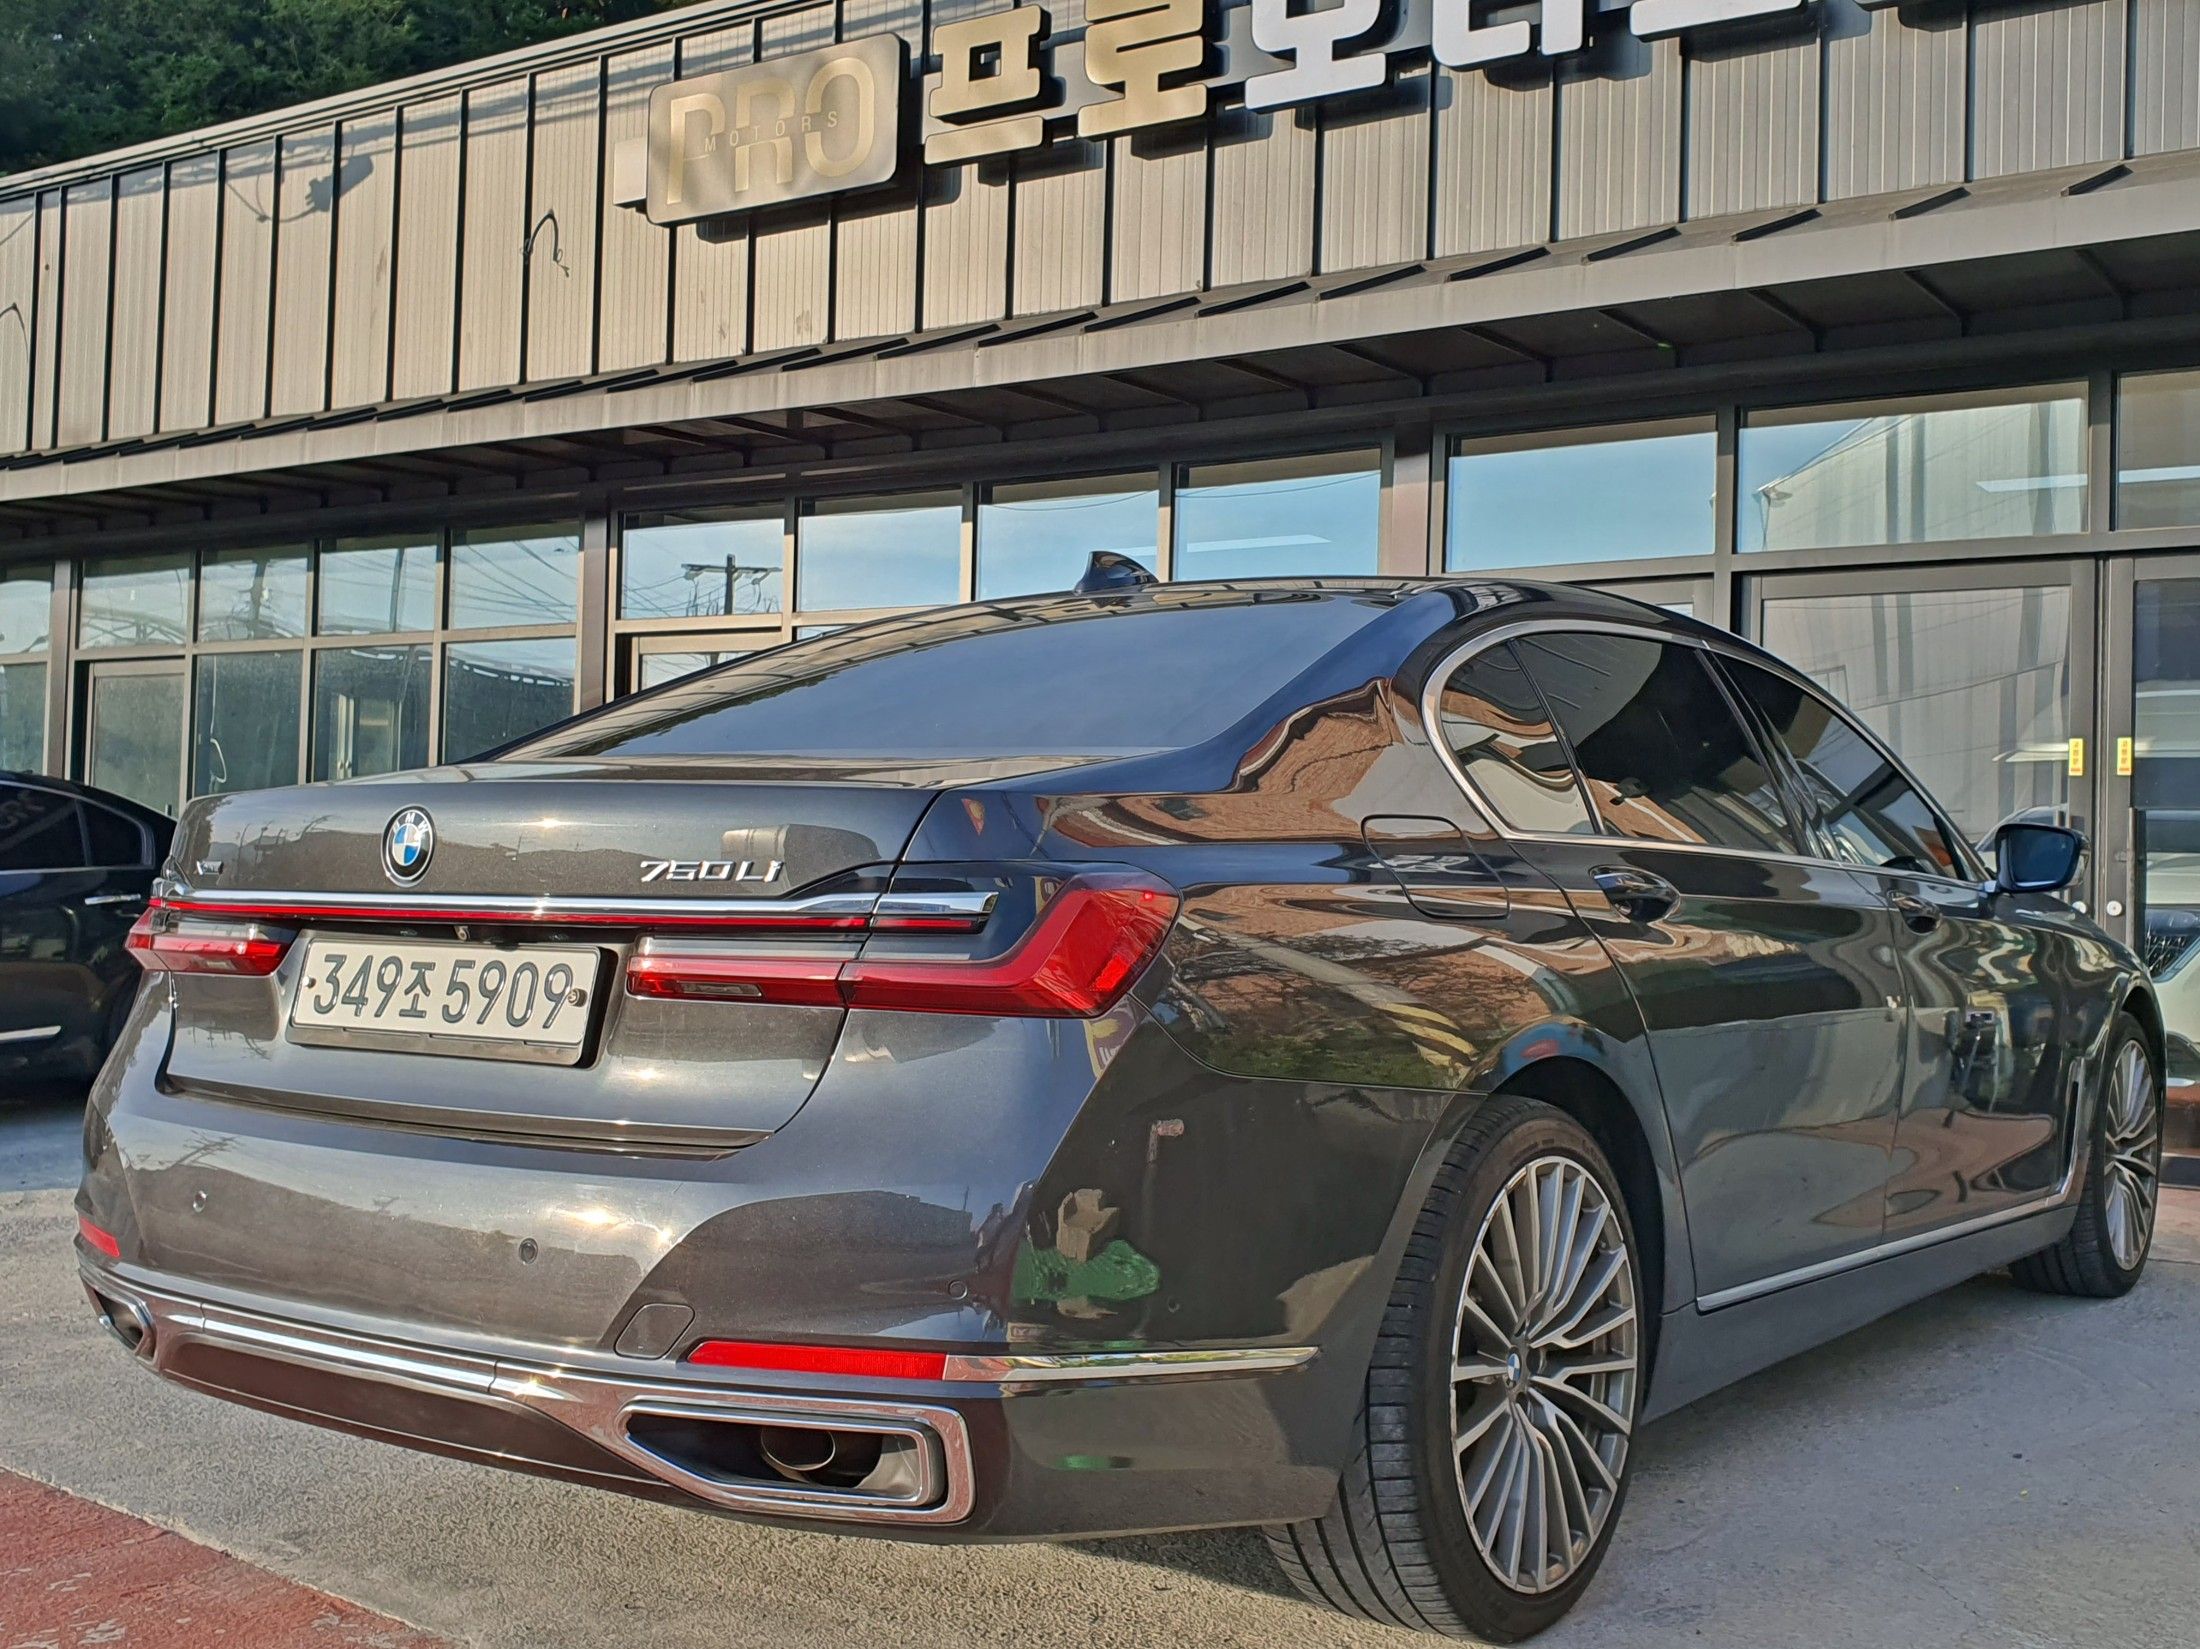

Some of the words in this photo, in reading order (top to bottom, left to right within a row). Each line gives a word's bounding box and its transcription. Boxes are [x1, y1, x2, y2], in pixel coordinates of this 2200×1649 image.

[667, 57, 875, 205] PRO
[704, 111, 839, 153] MOTORS
[924, 0, 1804, 165] 프로모
